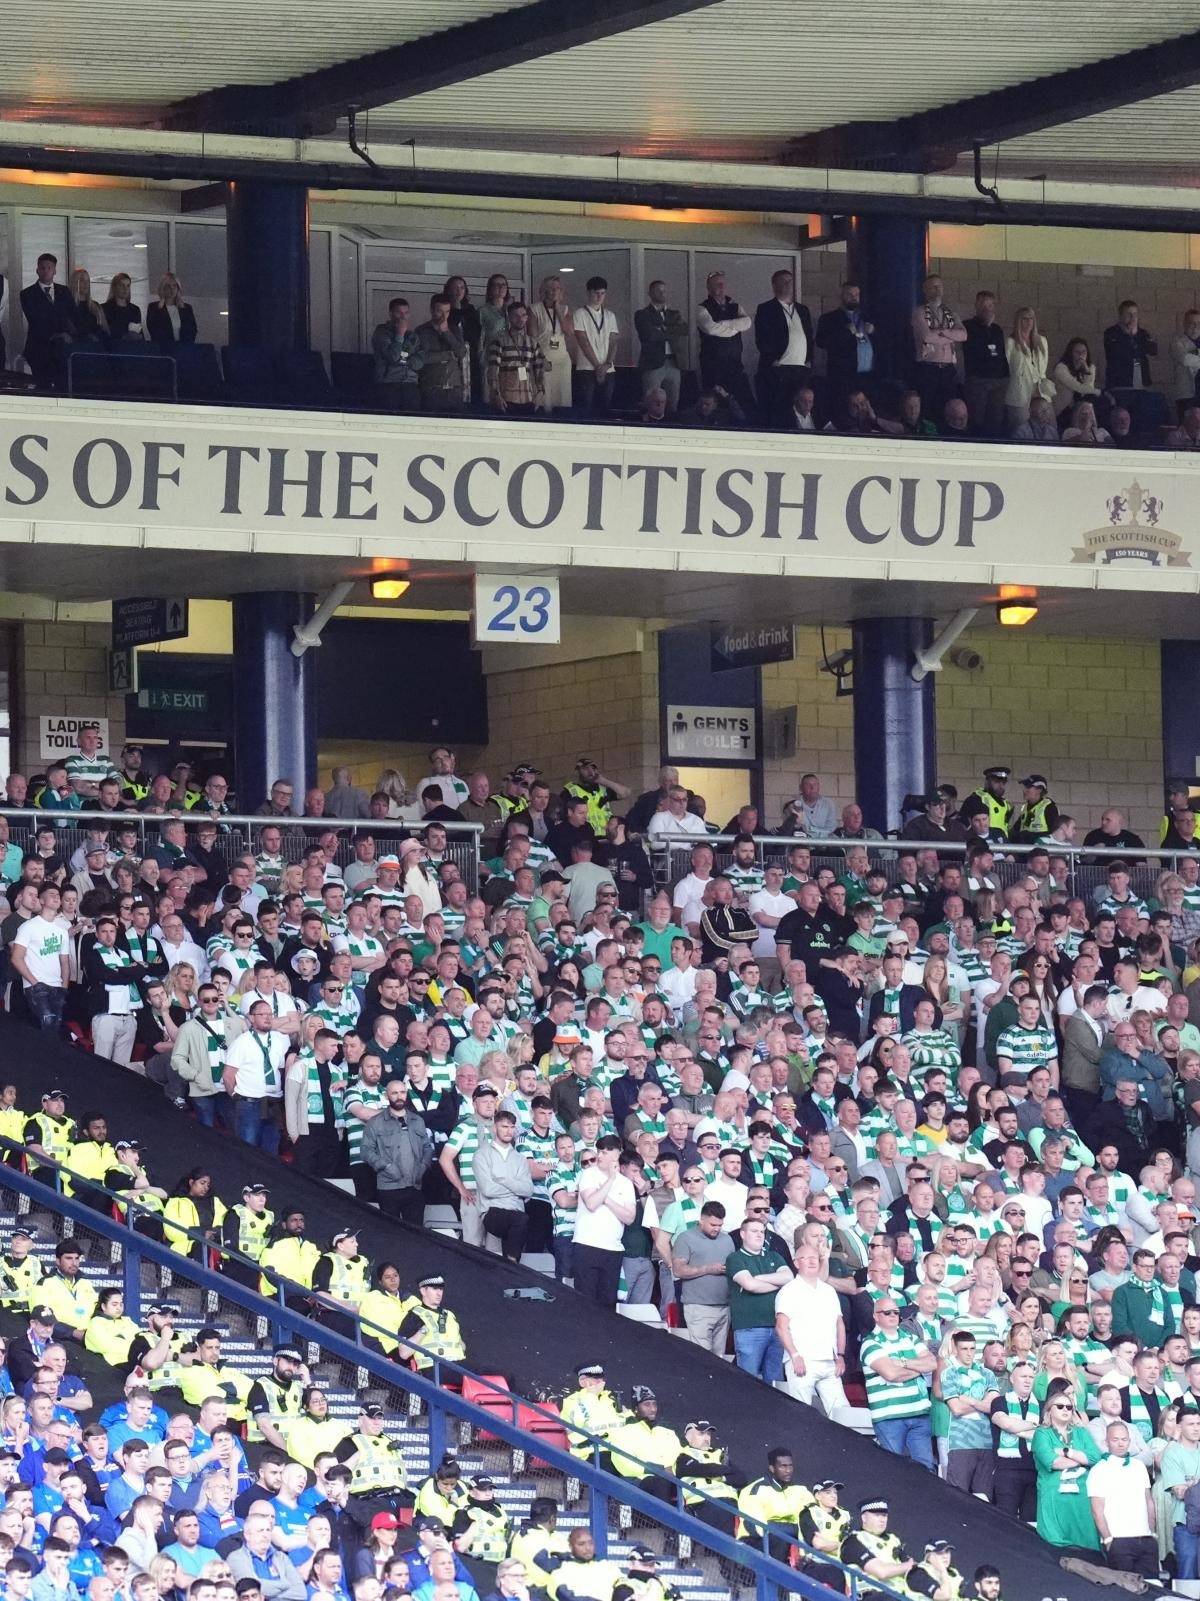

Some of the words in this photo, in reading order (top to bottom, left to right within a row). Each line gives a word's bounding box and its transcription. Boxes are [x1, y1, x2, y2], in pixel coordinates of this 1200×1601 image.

[71, 437, 186, 511] OF
[207, 444, 379, 521] THE
[402, 453, 823, 541] SCOTTISH
[844, 475, 1006, 548] CUP
[1087, 534, 1106, 546] THE
[1109, 532, 1157, 544] SCOTTISH
[1158, 537, 1176, 549] CUP
[1127, 549, 1149, 559] YEARS
[487, 585, 551, 633] 23
[173, 693, 205, 708] EXIT
[693, 716, 749, 732] GENTS
